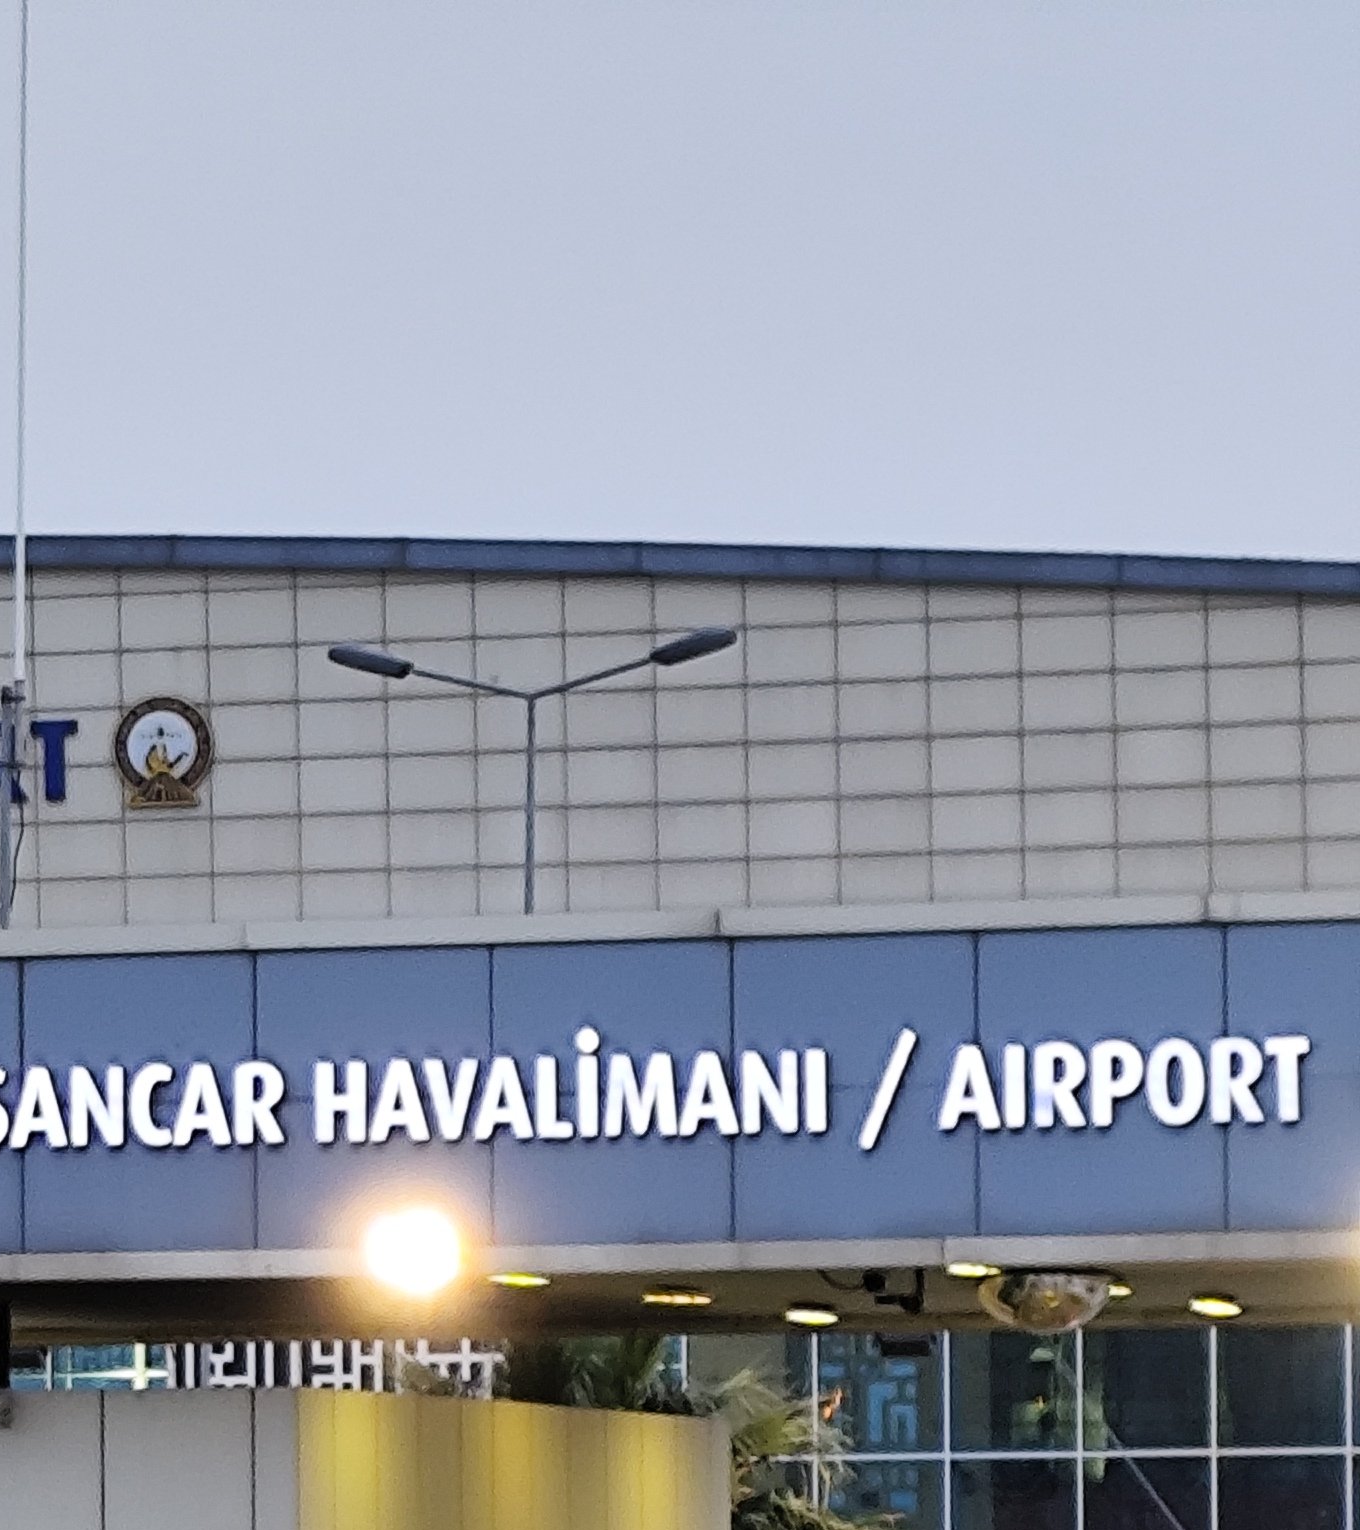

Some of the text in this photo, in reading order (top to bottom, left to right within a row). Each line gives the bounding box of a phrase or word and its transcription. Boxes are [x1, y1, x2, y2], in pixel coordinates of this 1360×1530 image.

[313, 1025, 828, 1145] HAVALİMANI
[858, 1027, 918, 1152] /
[937, 1033, 1312, 1132] AIRPORT
